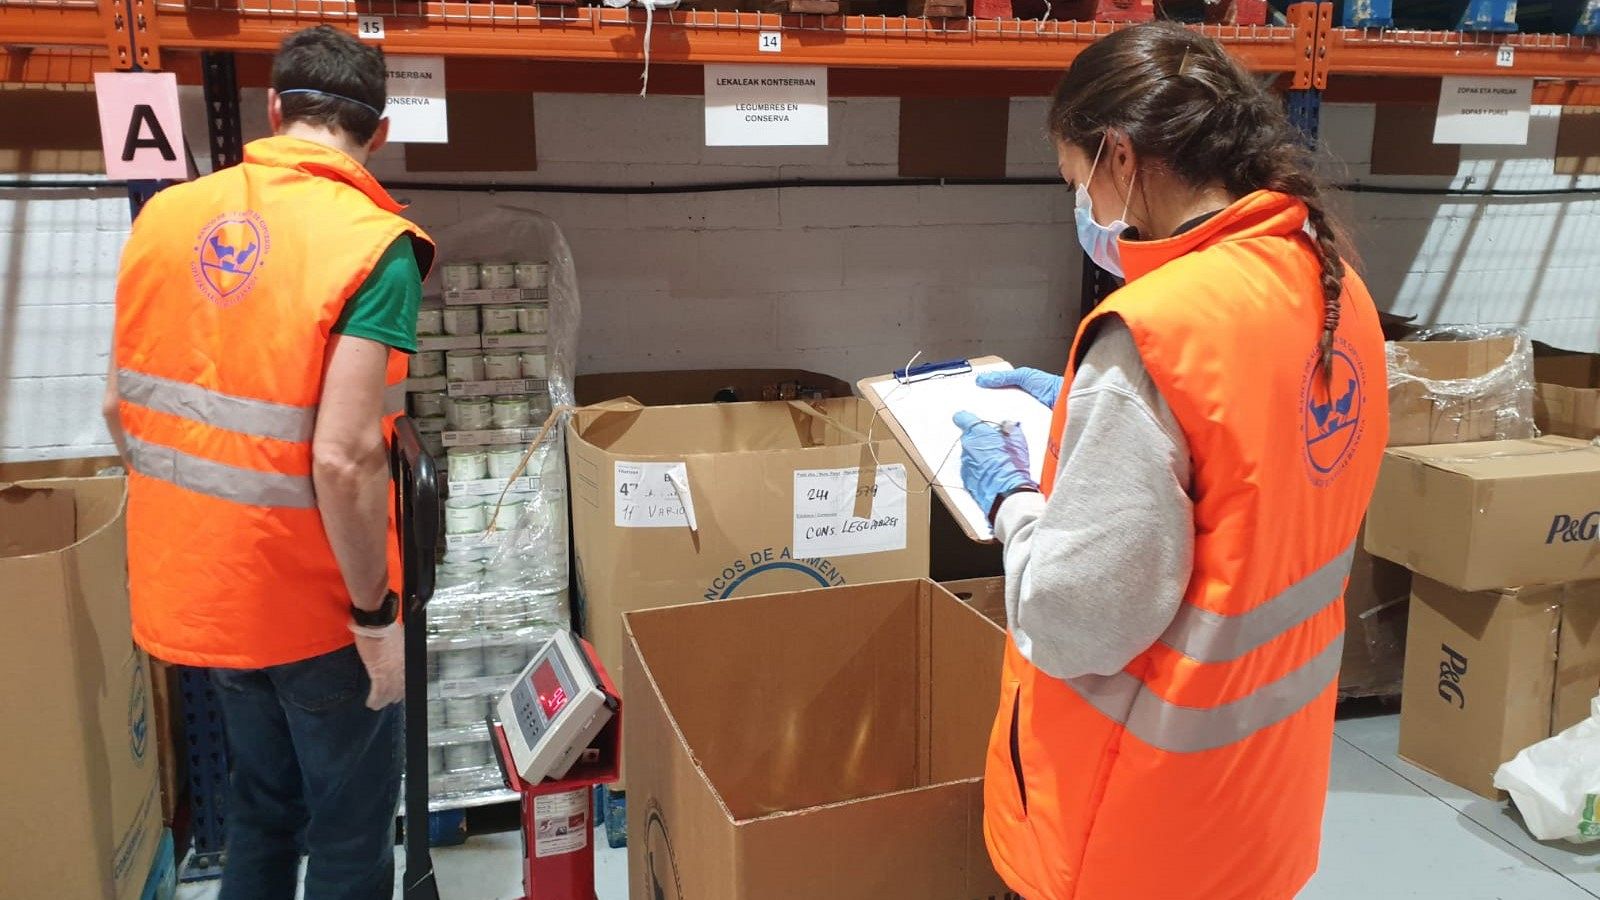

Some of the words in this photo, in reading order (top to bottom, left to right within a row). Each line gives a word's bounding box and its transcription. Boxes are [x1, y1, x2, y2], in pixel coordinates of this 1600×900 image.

[362, 21, 380, 34] 15
[762, 36, 778, 47] 14
[1500, 51, 1511, 61] 12
[716, 78, 759, 86] LEKALEAK
[761, 78, 816, 87] KONTSERBAN
[386, 97, 430, 105] ONSERVA
[735, 103, 785, 111] LEGUMBRES
[787, 103, 798, 111] EN
[745, 114, 790, 122] CONSERVA
[121, 104, 177, 162] A
[1545, 511, 1600, 544] P&G
[704, 560, 746, 600] NCOS
[750, 547, 774, 565] DE
[1439, 643, 1467, 709] P&G
